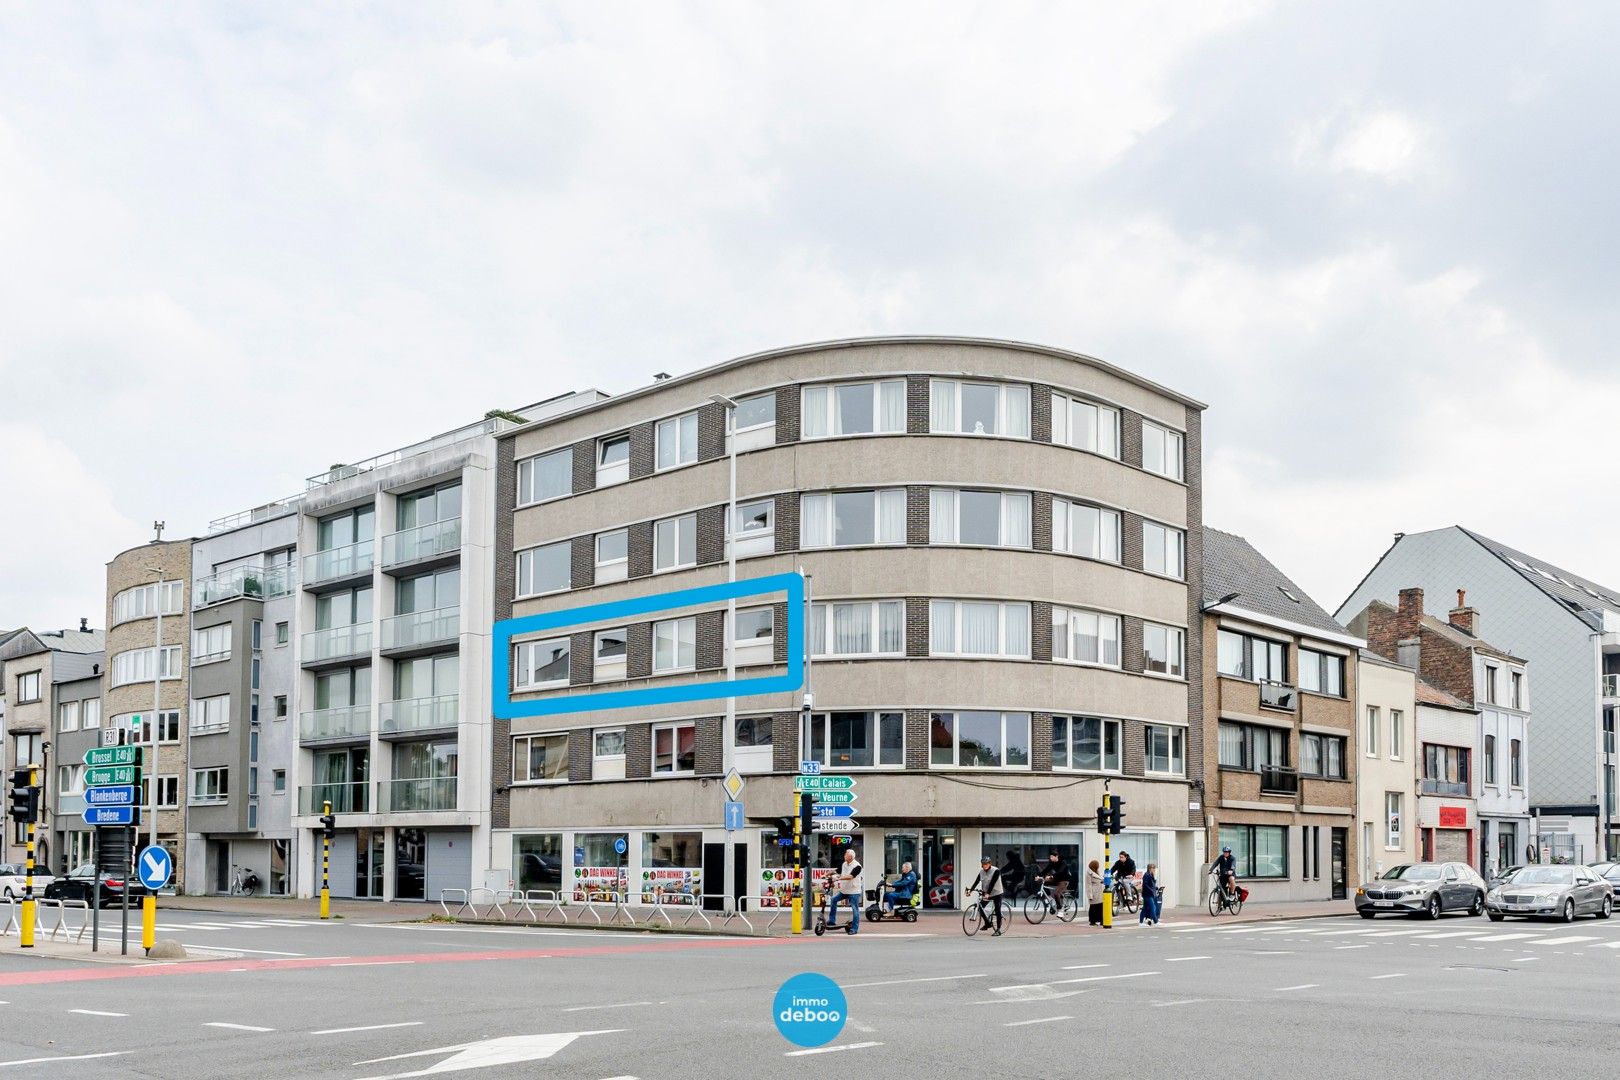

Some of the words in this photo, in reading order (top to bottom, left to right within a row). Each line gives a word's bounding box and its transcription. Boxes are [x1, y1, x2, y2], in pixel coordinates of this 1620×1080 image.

[803, 763, 819, 773] N33
[92, 771, 110, 783] Brugge
[805, 778, 819, 787] E40
[822, 778, 846, 788] Calais
[91, 789, 128, 802] Blankenberge
[822, 792, 848, 802] Veurne
[97, 809, 119, 821] Bredene
[589, 868, 599, 877] DAG
[657, 870, 667, 879] DAG
[667, 870, 684, 879] WINKEL
